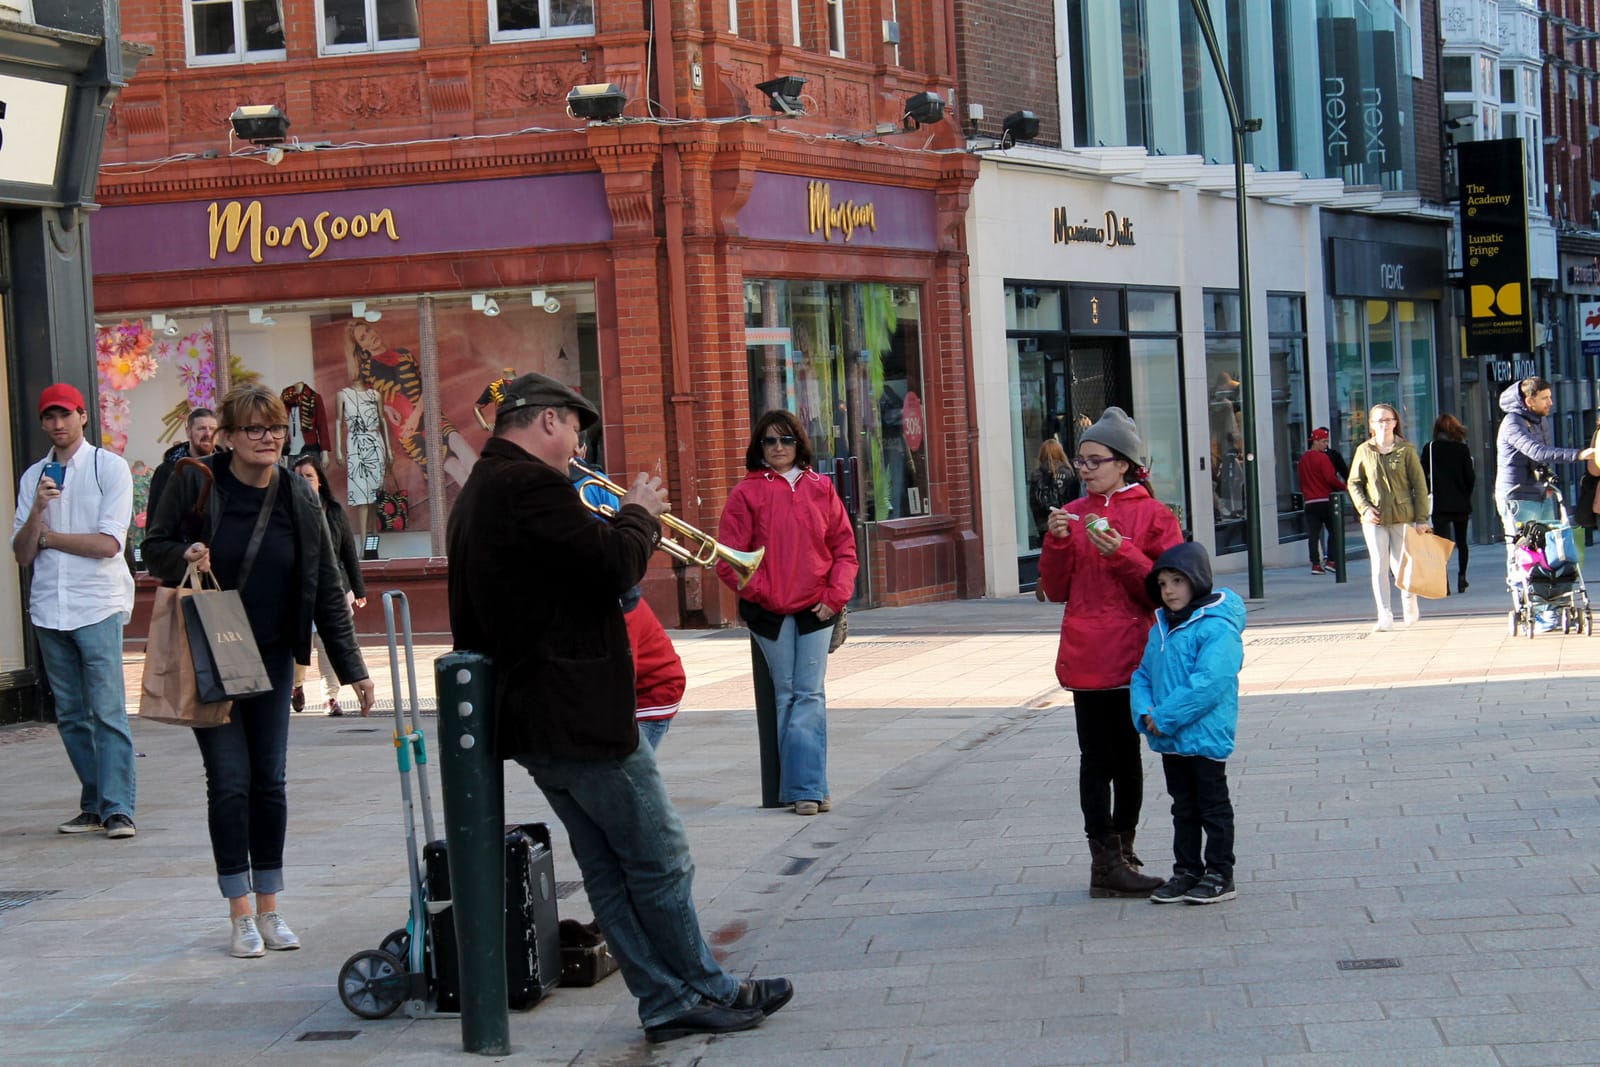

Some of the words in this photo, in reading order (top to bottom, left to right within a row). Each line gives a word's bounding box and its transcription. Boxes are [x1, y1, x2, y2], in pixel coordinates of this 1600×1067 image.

[1325, 77, 1348, 156] next
[1361, 87, 1386, 164] next
[1466, 184, 1485, 194] The
[1467, 194, 1511, 206] Academy
[807, 179, 877, 242] Monsoon
[206, 199, 400, 264] Monsoon
[1468, 233, 1504, 244] Lunatic
[1469, 246, 1500, 257] Fringe
[1380, 263, 1405, 290] next
[1491, 360, 1512, 382] VERO
[1514, 359, 1536, 381] MODA
[904, 418, 921, 435] 30%
[216, 631, 243, 643] ZARA
